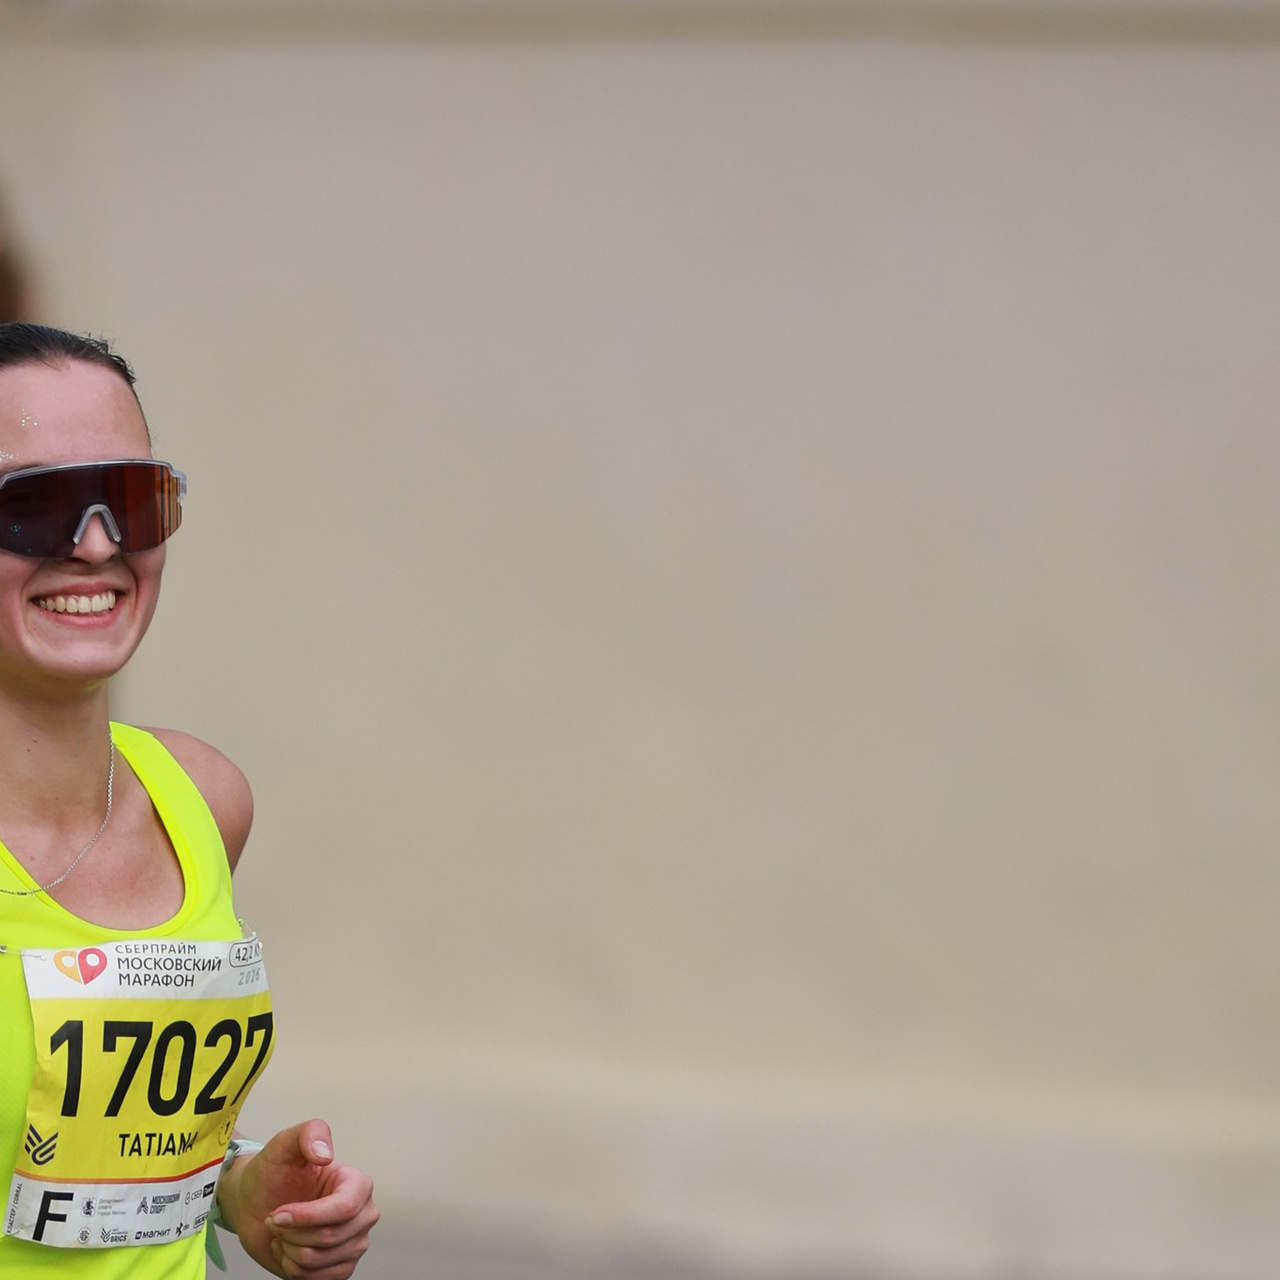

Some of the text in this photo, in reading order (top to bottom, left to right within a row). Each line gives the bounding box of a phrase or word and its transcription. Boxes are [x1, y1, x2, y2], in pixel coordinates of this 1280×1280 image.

[115, 942, 197, 954] СБЕРПРАЙМ
[117, 956, 222, 972] МОСКОВСКИЙ
[118, 973, 195, 987] МАРАФОН
[49, 1011, 274, 1118] 17027
[32, 1190, 74, 1242] F
